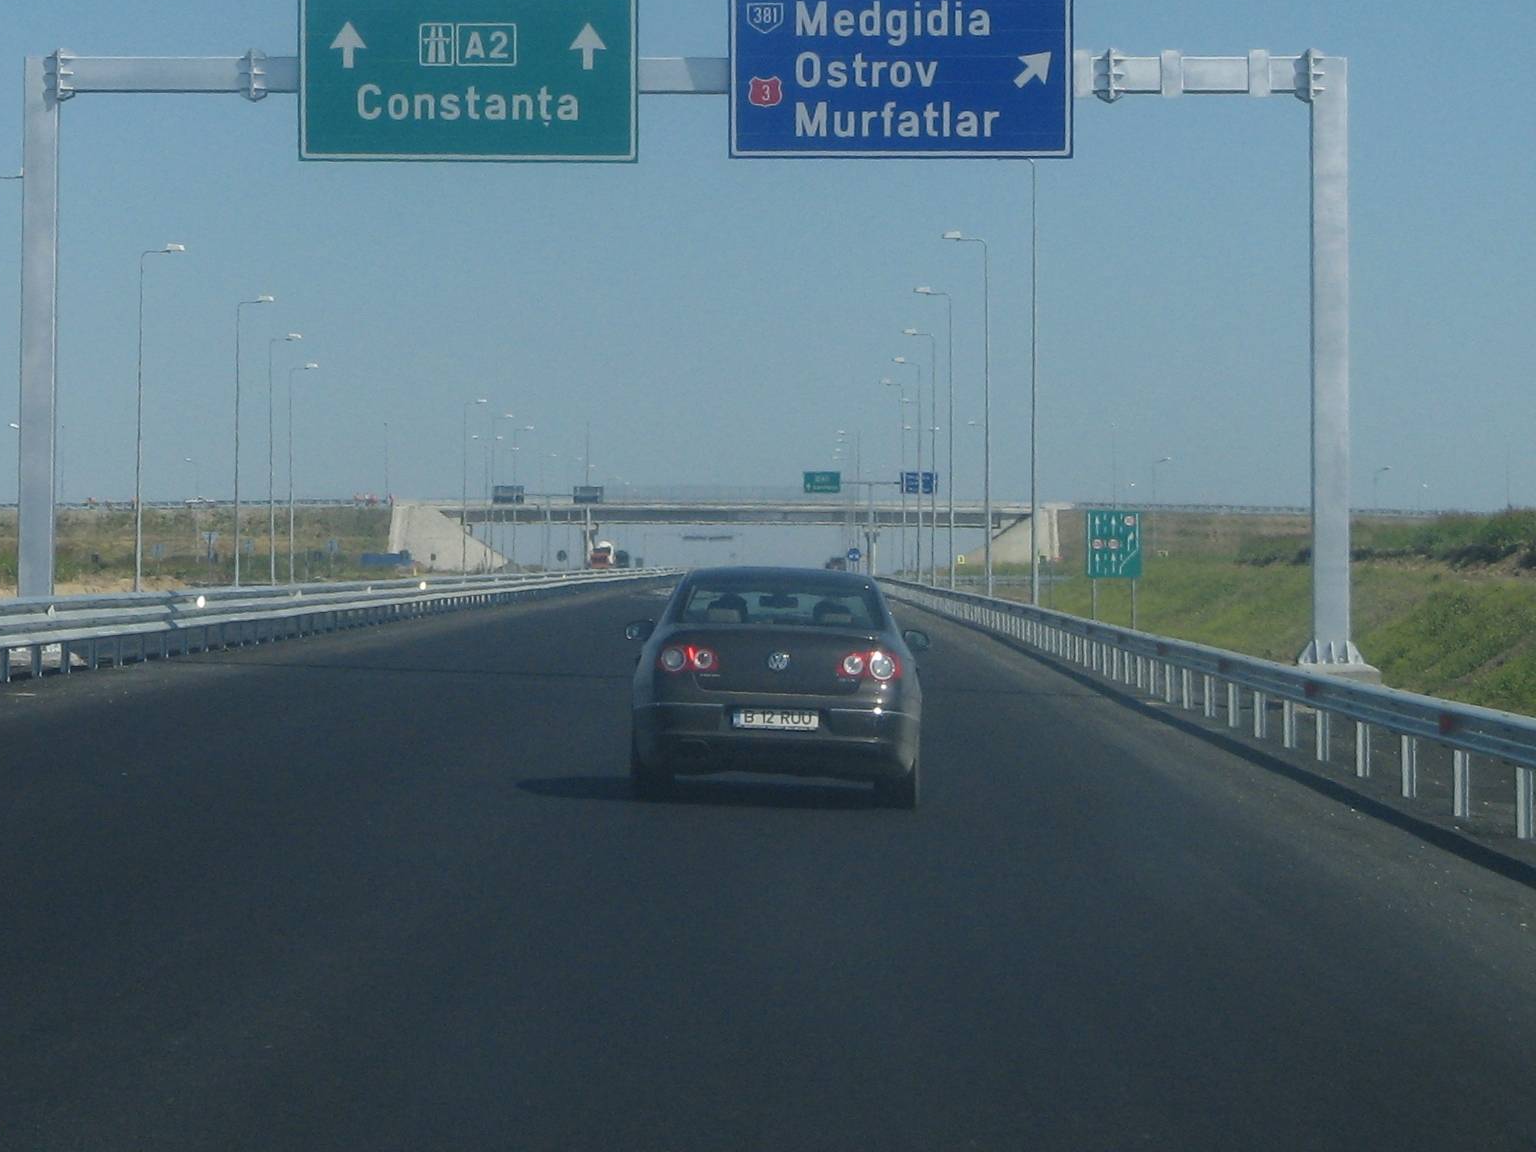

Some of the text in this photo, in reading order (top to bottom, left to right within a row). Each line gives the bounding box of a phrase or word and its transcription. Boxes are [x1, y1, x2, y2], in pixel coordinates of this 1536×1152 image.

[752, 6, 777, 25] 381
[795, 0, 991, 47] Medgidia
[464, 31, 508, 59] A2
[795, 51, 938, 88] Ostrov
[356, 83, 579, 127] Constanța
[761, 84, 771, 102] 3
[795, 101, 1000, 138] Murfatlar
